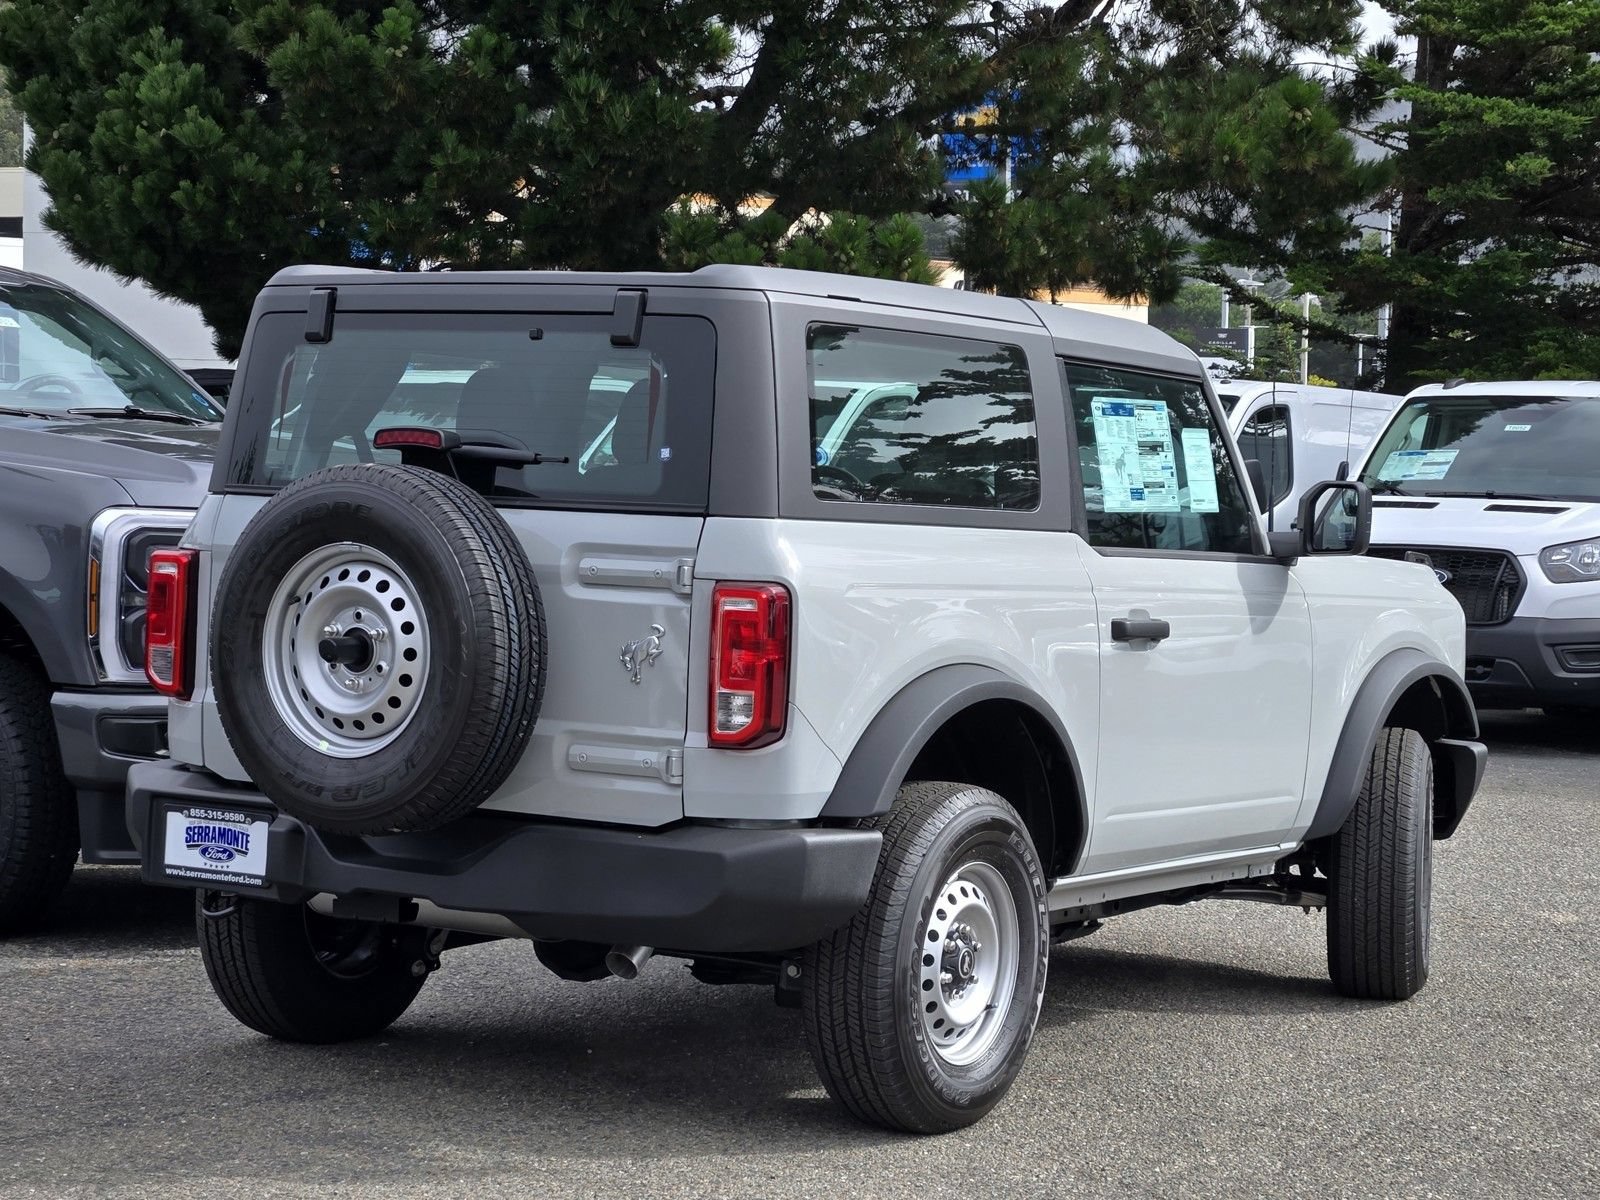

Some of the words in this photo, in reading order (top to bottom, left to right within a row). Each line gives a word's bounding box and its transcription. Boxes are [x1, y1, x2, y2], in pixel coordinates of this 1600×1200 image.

[189, 808, 245, 822] 855-315-9580
[185, 826, 250, 850] SERRAMONTE
[204, 846, 229, 860] Ford
[165, 867, 262, 885] www.serramonteford.com
